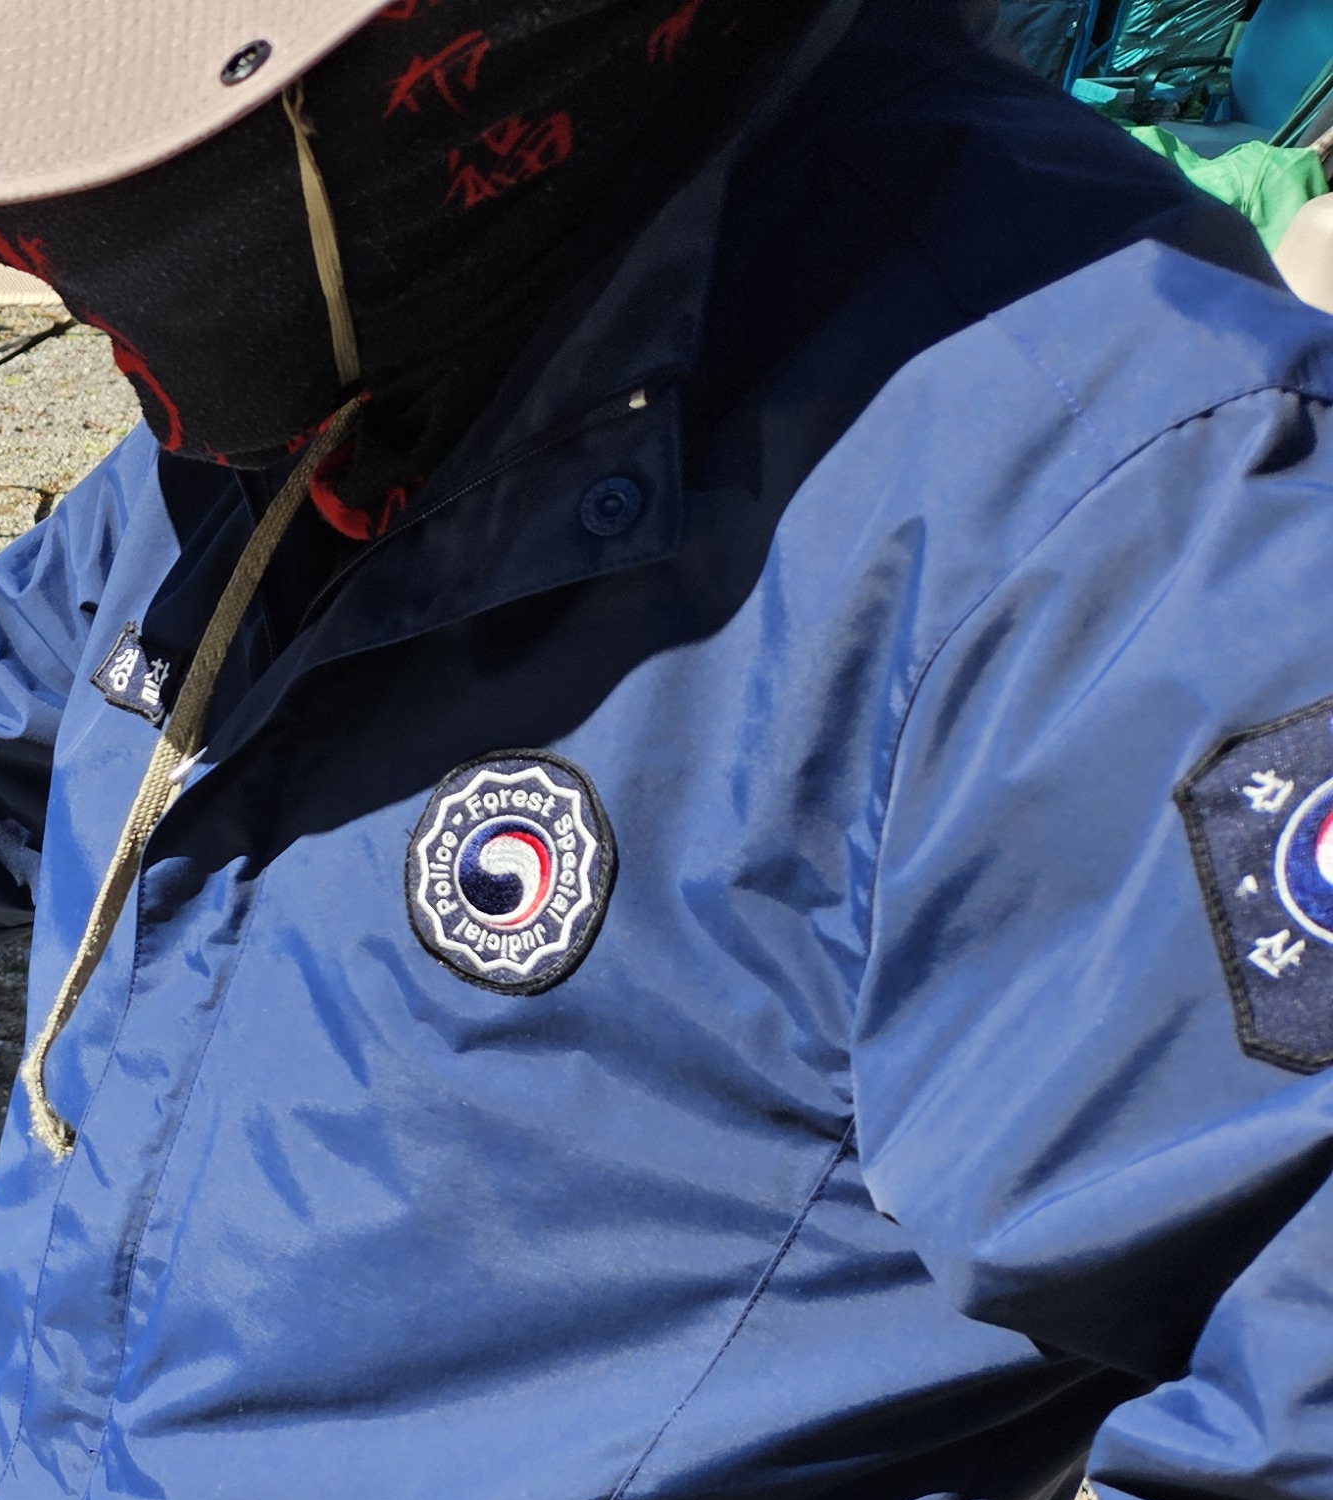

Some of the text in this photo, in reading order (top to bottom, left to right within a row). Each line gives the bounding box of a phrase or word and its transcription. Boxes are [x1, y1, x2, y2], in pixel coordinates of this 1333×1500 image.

[429, 788, 579, 962] Forest Special Judicial Police
